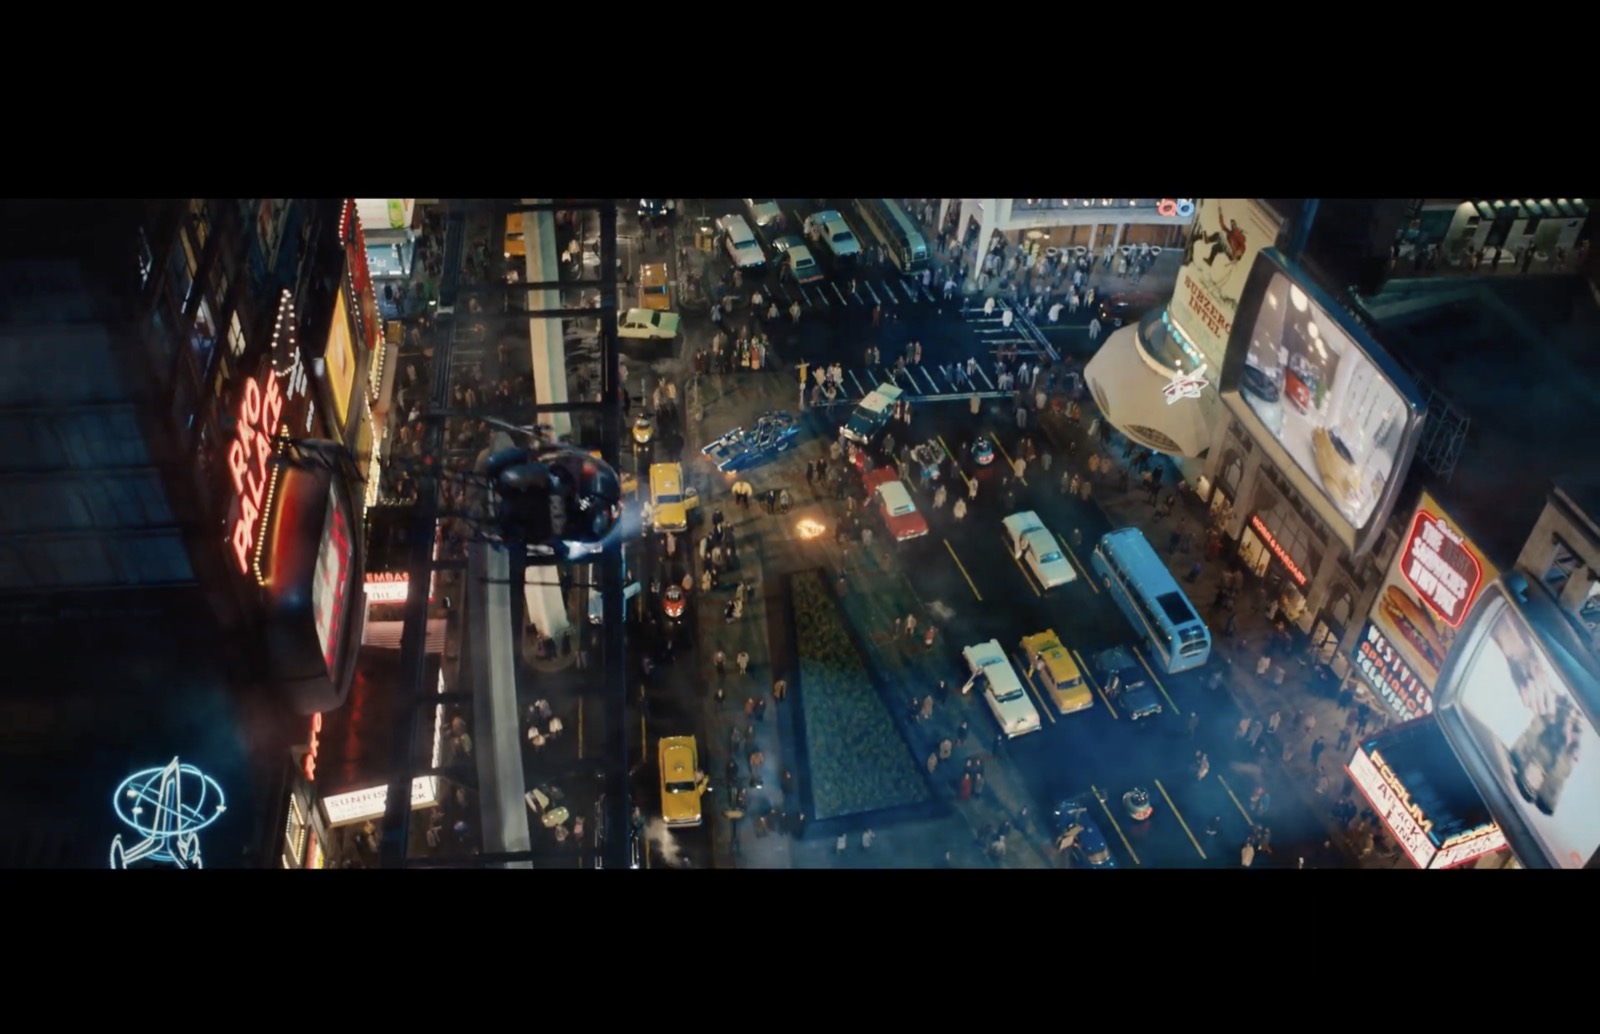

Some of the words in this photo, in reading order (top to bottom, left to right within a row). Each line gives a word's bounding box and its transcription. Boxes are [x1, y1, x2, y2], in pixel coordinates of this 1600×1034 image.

[229, 376, 261, 495] RKO
[231, 367, 284, 575] PALACE
[365, 572, 410, 583] EMBAS
[330, 789, 387, 808] SUNRIS
[1370, 750, 1433, 834] FORUM
[1378, 783, 1420, 840] ATTACK
